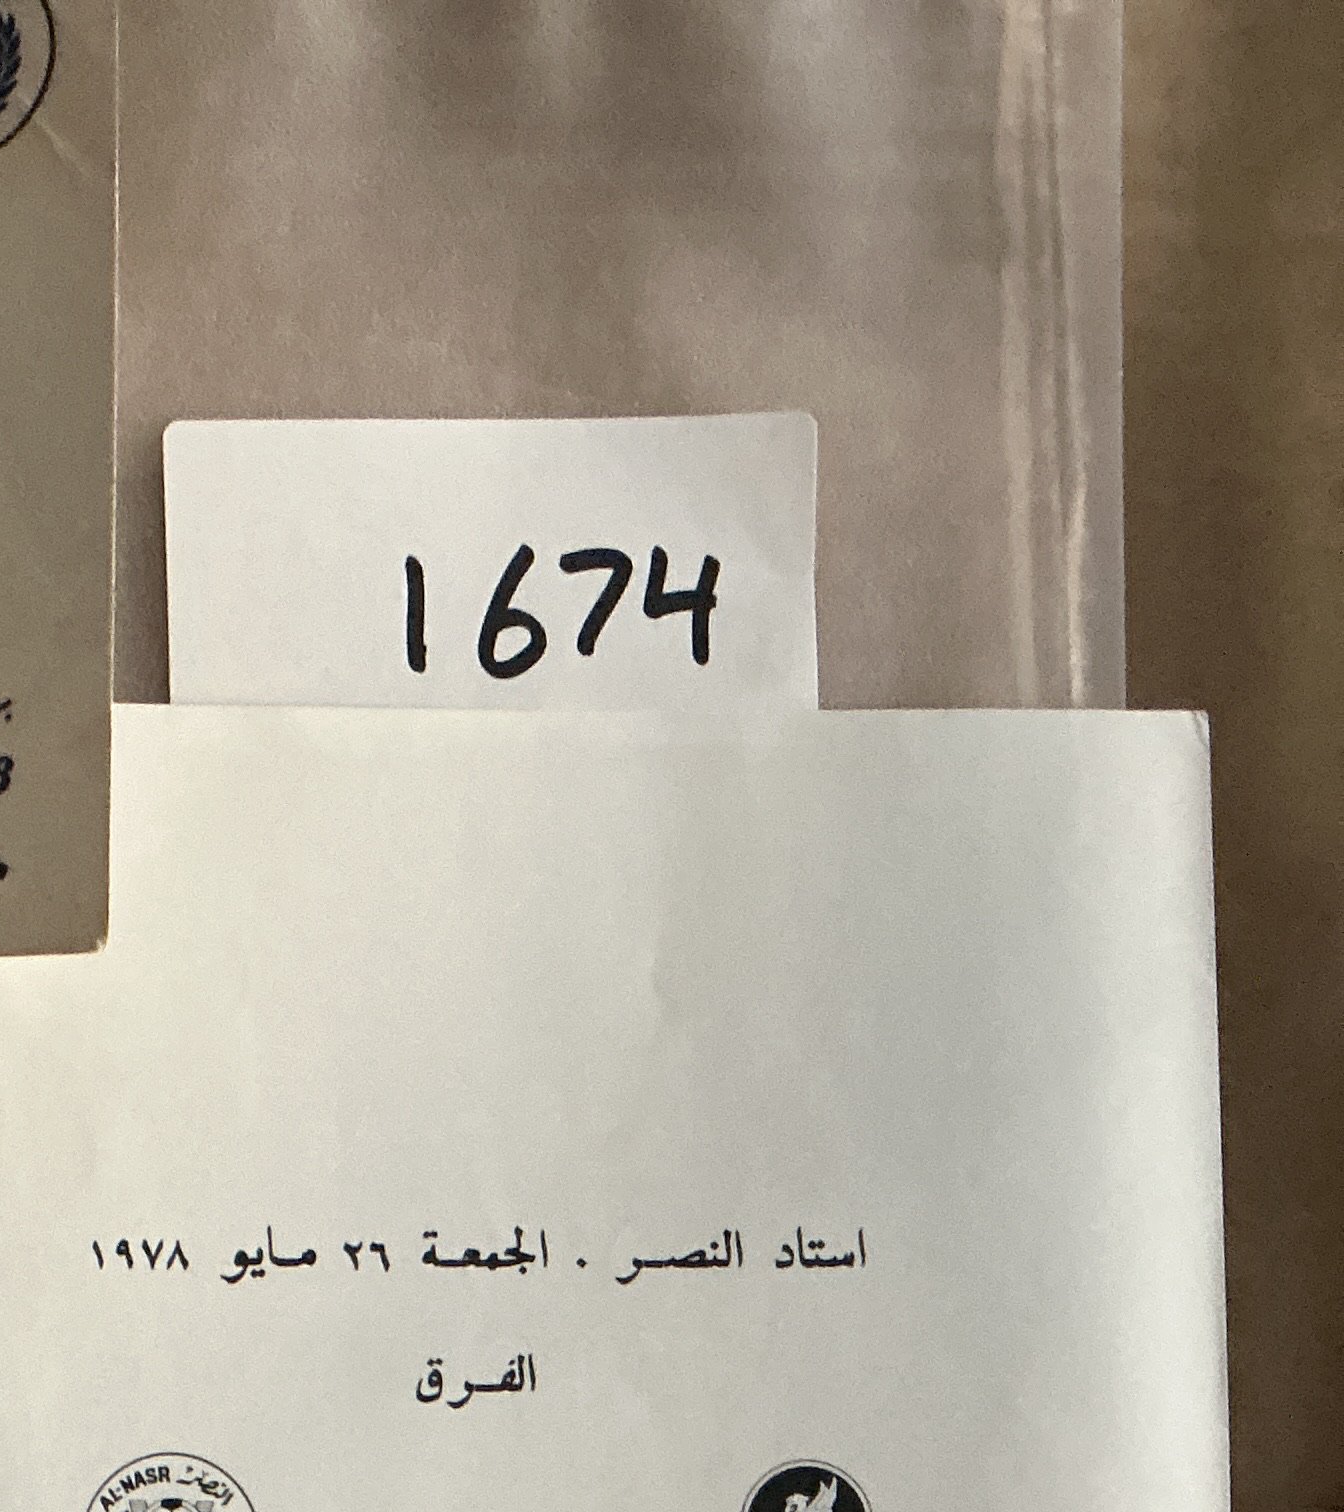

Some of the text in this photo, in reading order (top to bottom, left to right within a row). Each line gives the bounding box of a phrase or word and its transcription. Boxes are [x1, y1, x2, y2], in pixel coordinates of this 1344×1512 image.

[405, 544, 721, 679] 1674
[91, 1225, 867, 1286] استاد النصر الجمعة ٢٦ مايو ١٩٧٨
[415, 1353, 537, 1410] الفرق
